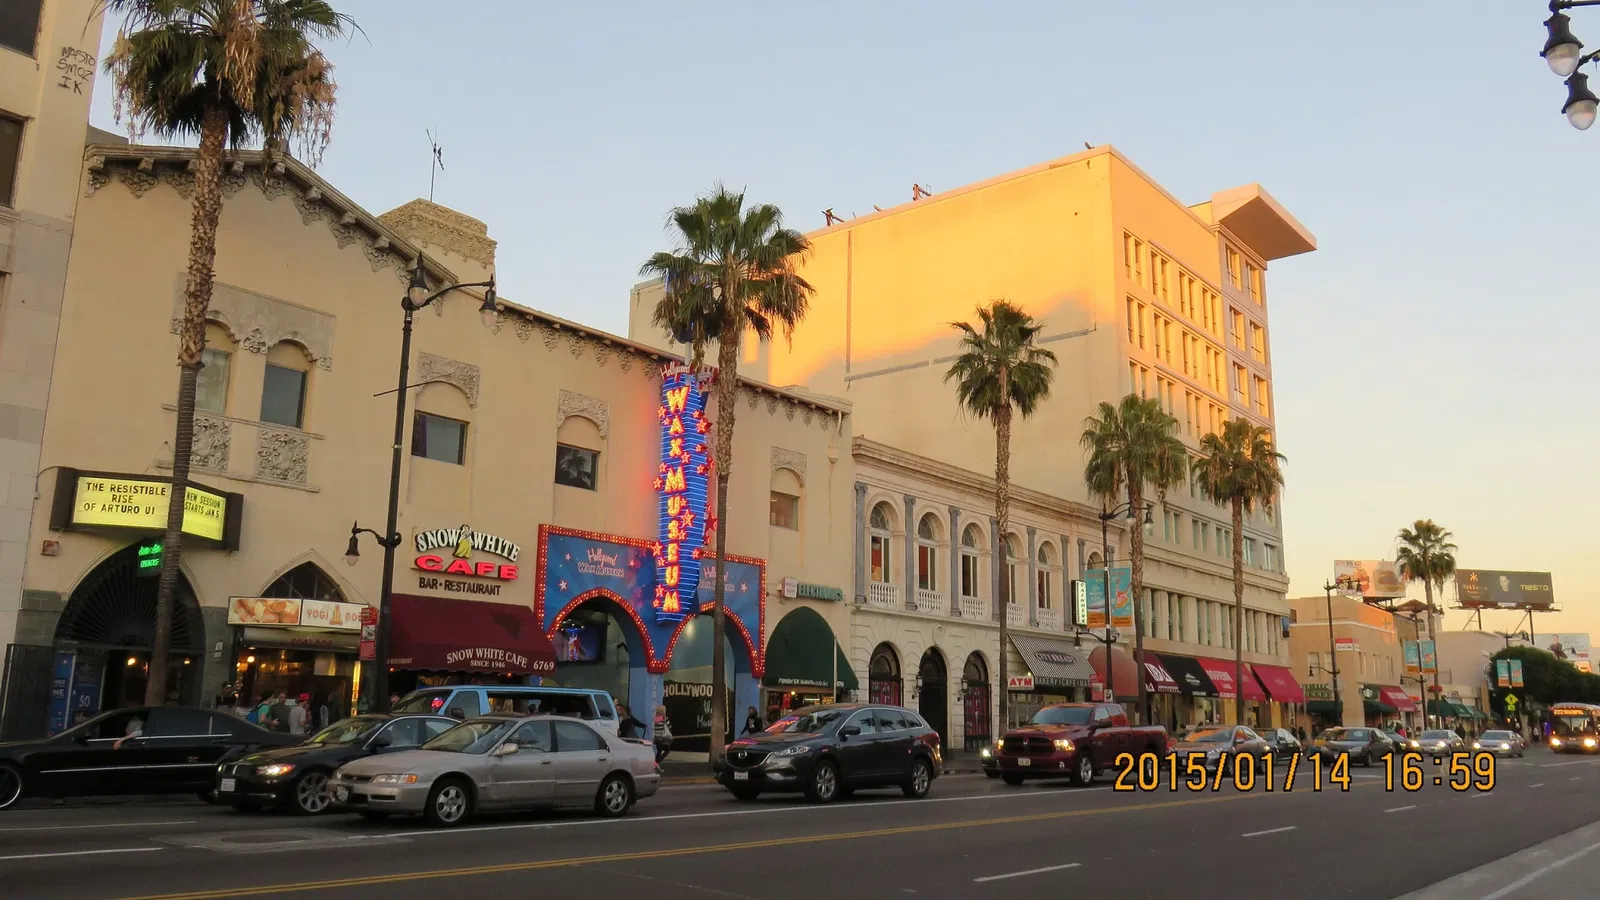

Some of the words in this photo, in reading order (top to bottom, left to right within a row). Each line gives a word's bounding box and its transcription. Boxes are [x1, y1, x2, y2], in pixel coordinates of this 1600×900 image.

[660, 361, 692, 381] Hollywood
[666, 385, 691, 457] WAX
[86, 482, 104, 492] THE
[110, 483, 167, 496] RESISTIBLE
[111, 494, 134, 504] RISE
[186, 491, 198, 502] NEW
[199, 493, 221, 508] SESSION
[83, 502, 96, 512] OF
[101, 504, 140, 514] ARTURO
[145, 506, 155, 515] UI
[184, 501, 204, 515] STARTS
[205, 507, 215, 518] JAN
[415, 528, 463, 552] SNOW
[472, 530, 521, 562] WHITE
[662, 464, 687, 613] MUSEUM
[414, 554, 519, 580] CAFE
[595, 564, 625, 578] MUSEUM
[418, 576, 438, 590] BAR
[444, 579, 502, 597] RESTAURANT
[446, 648, 474, 664] SNOW
[475, 648, 505, 661] WHITE
[505, 651, 528, 669] CAFE
[533, 660, 555, 671] 6769
[470, 659, 490, 668] SINCE
[491, 660, 506, 668] 1946
[1009, 678, 1032, 687] ATM
